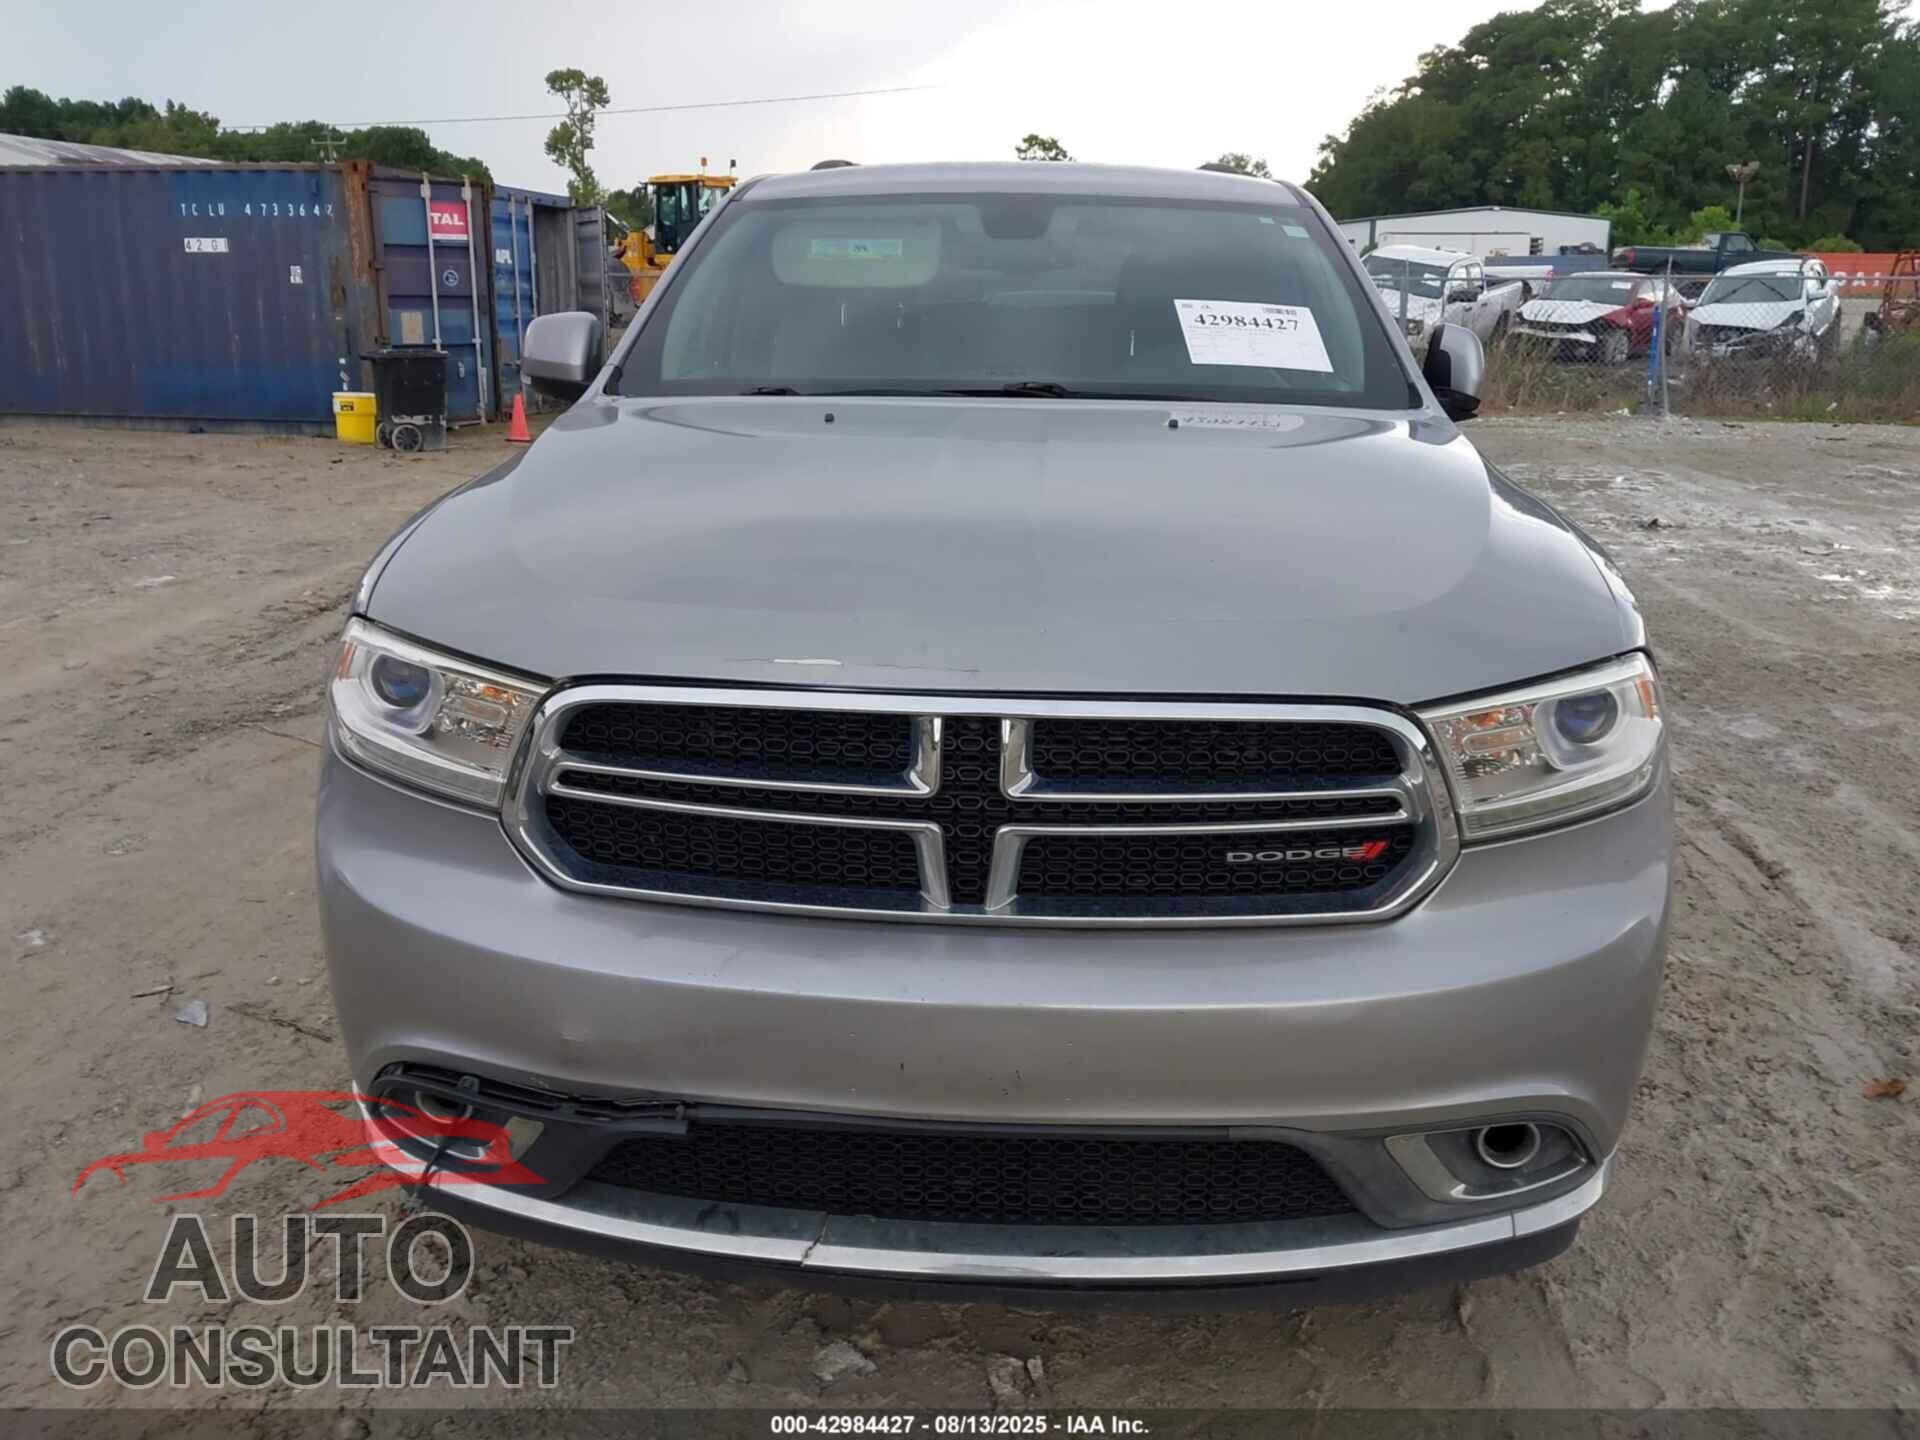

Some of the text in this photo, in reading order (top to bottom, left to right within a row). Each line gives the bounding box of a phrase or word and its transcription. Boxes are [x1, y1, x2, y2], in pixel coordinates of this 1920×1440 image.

[430, 212, 464, 226] TAL
[1194, 314, 1298, 331] 42984427
[1226, 847, 1366, 862] DODGE
